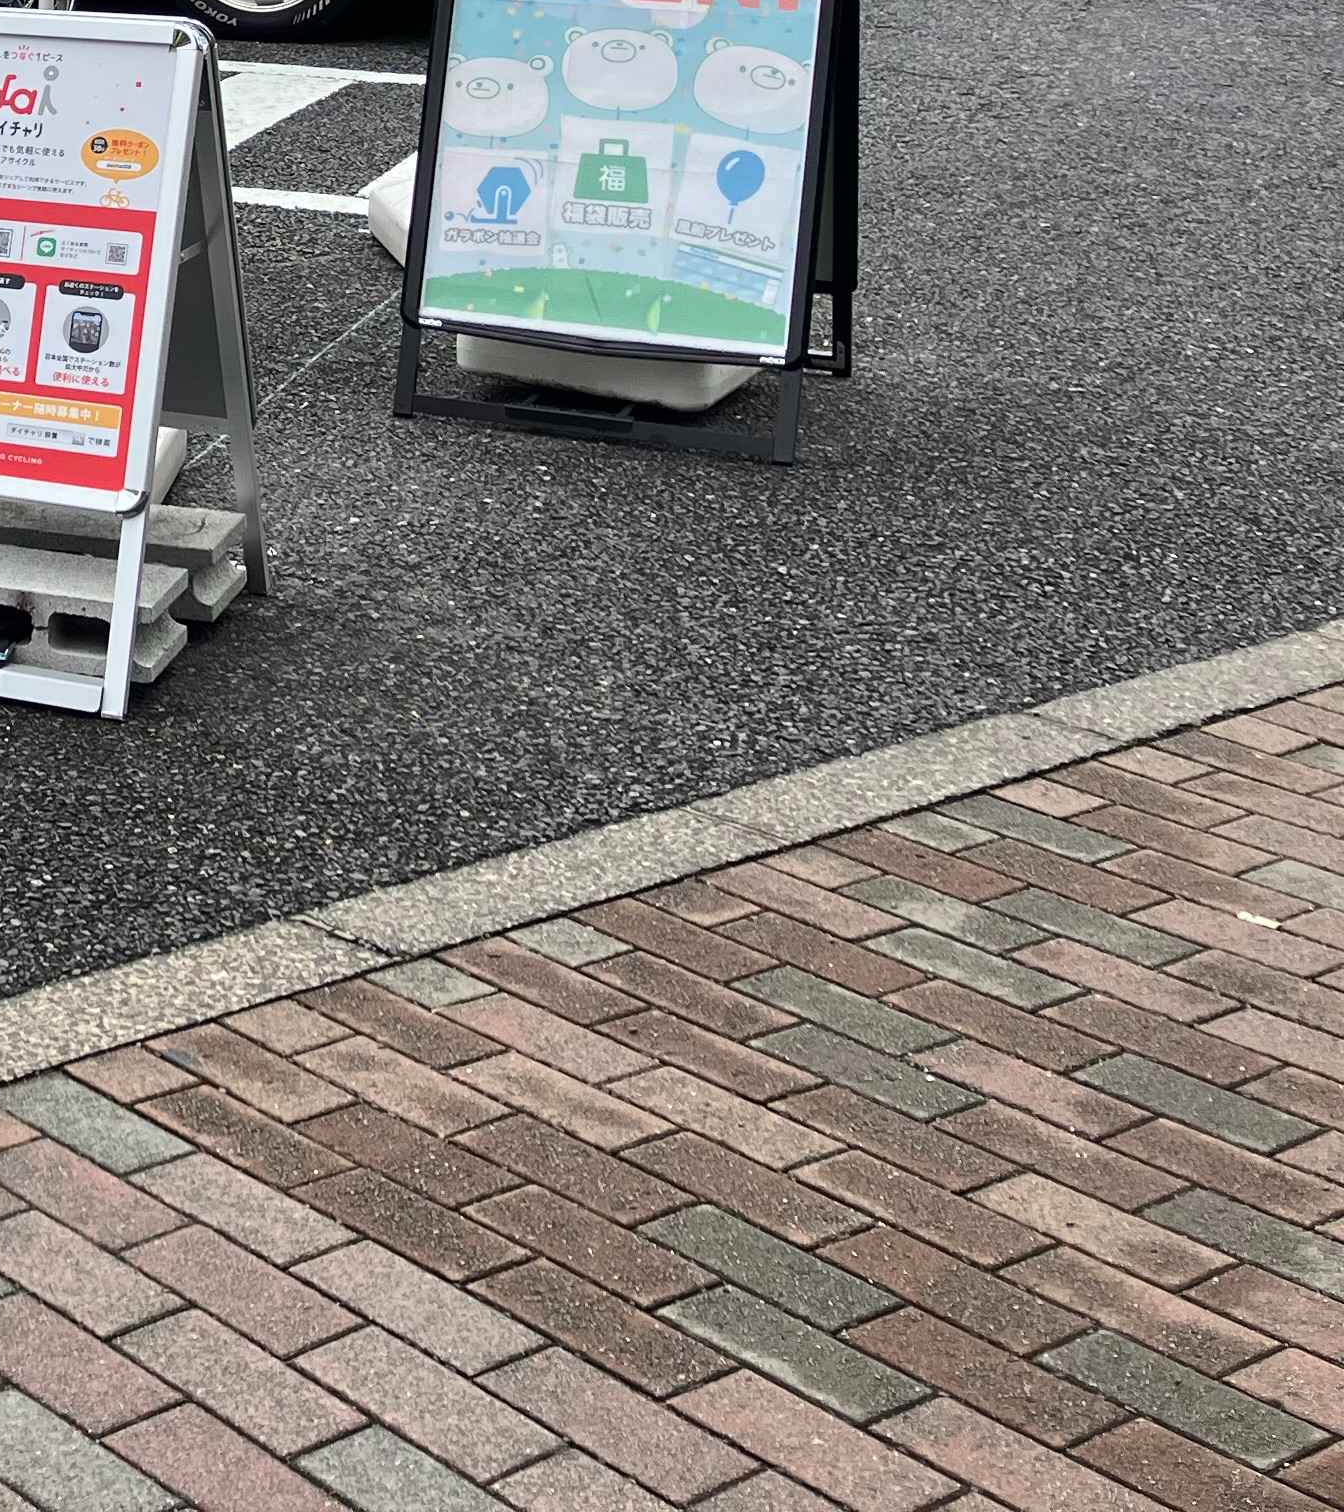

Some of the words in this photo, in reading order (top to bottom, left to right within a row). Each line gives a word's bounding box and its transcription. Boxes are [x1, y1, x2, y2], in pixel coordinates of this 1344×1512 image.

[598, 165, 626, 193] 福
[561, 201, 653, 231] 福袋販売
[52, 371, 110, 388] 便利に使える
[7, 453, 43, 465] CYCLING
